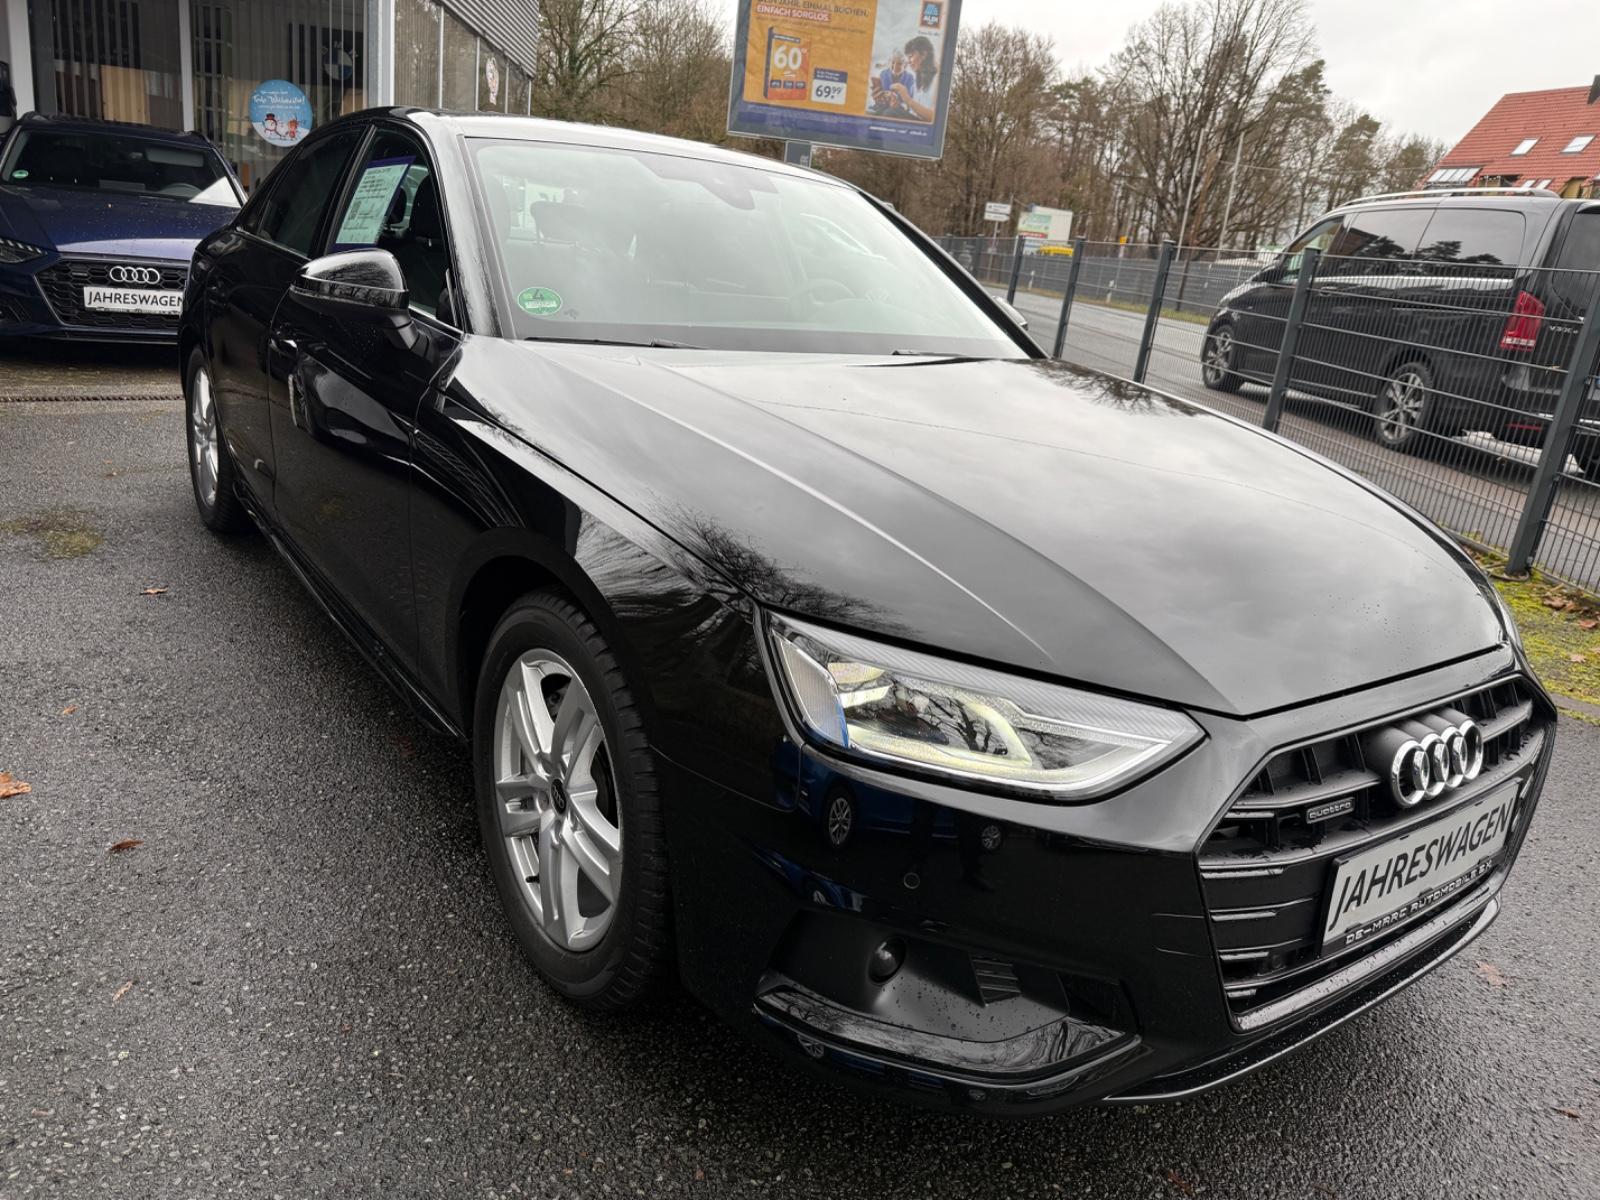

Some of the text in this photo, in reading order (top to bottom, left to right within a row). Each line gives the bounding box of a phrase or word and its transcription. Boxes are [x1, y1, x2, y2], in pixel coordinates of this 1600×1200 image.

[757, 5, 791, 17] EINFACH
[1309, 801, 1351, 819] quattro
[1329, 797, 1513, 931] JAHRESWAGEN
[1410, 869, 1478, 913] AUTOMOBILE
